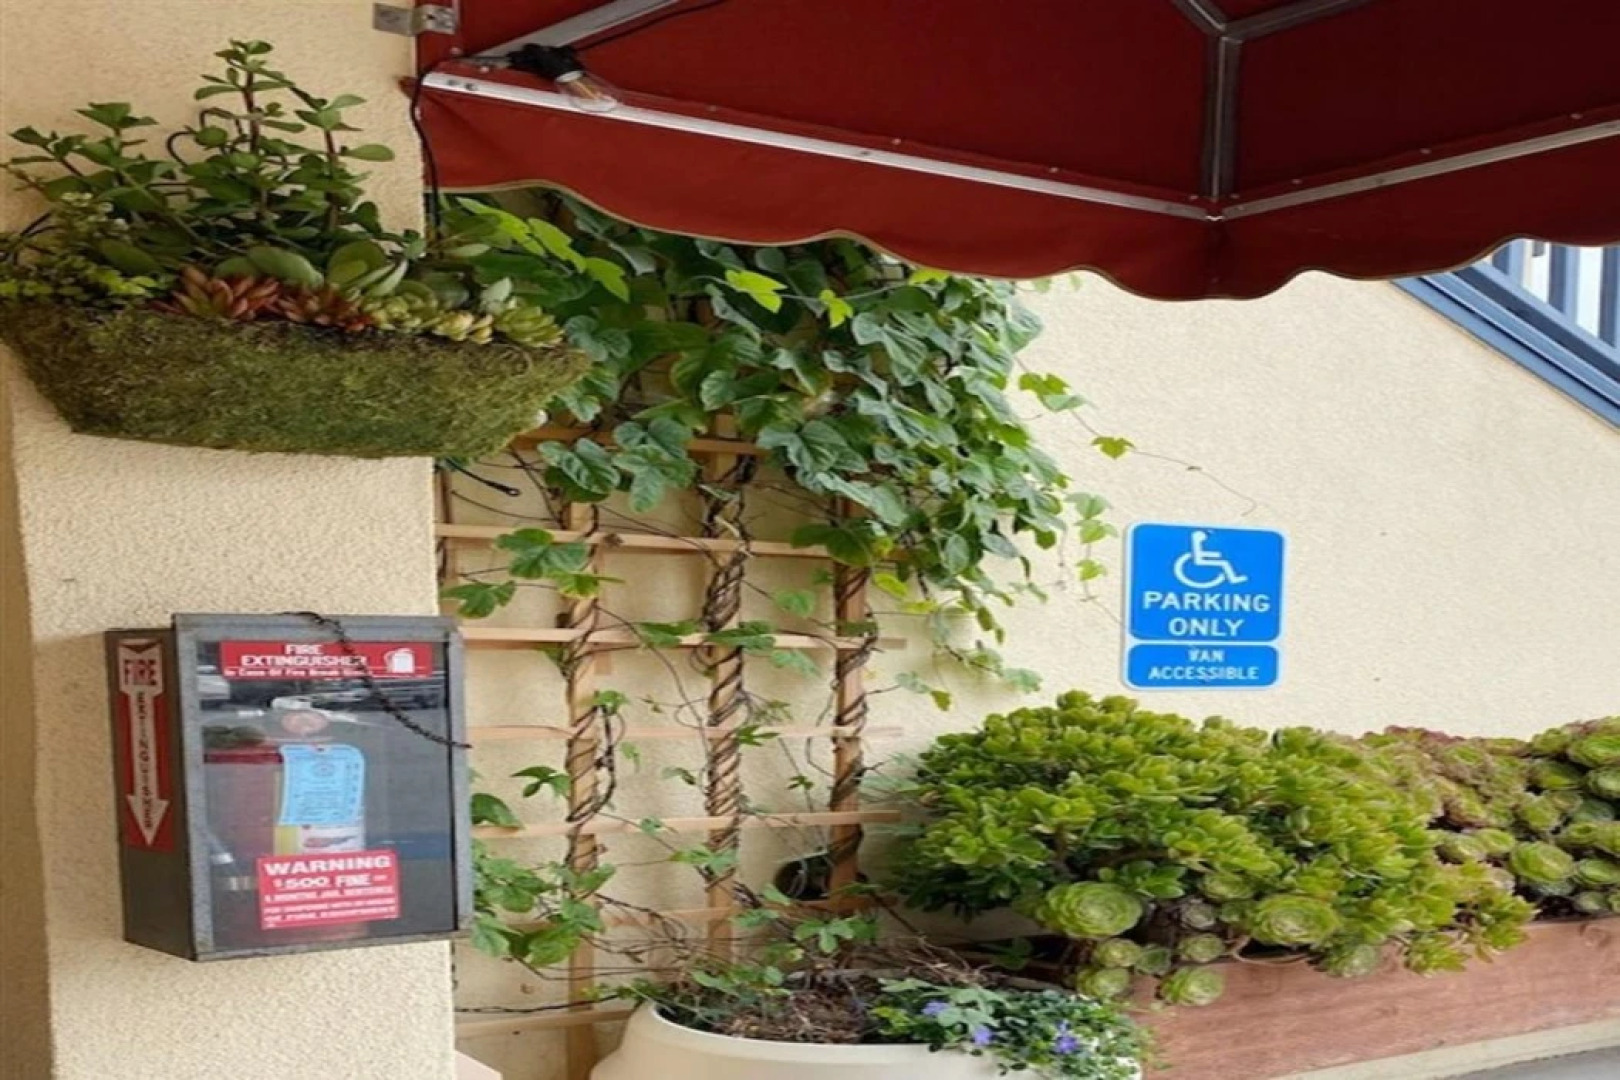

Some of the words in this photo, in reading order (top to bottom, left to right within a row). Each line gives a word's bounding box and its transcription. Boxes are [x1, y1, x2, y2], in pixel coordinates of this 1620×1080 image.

[1142, 590, 1271, 613] PARKING
[1168, 617, 1245, 637] ONLY
[285, 644, 323, 655] FIRE
[1187, 648, 1225, 663] VAN
[241, 655, 367, 666] EXTINGUISHER
[123, 658, 158, 686] FIRE
[1148, 666, 1259, 680] ACCESSIBLE
[263, 855, 391, 876] WARNING
